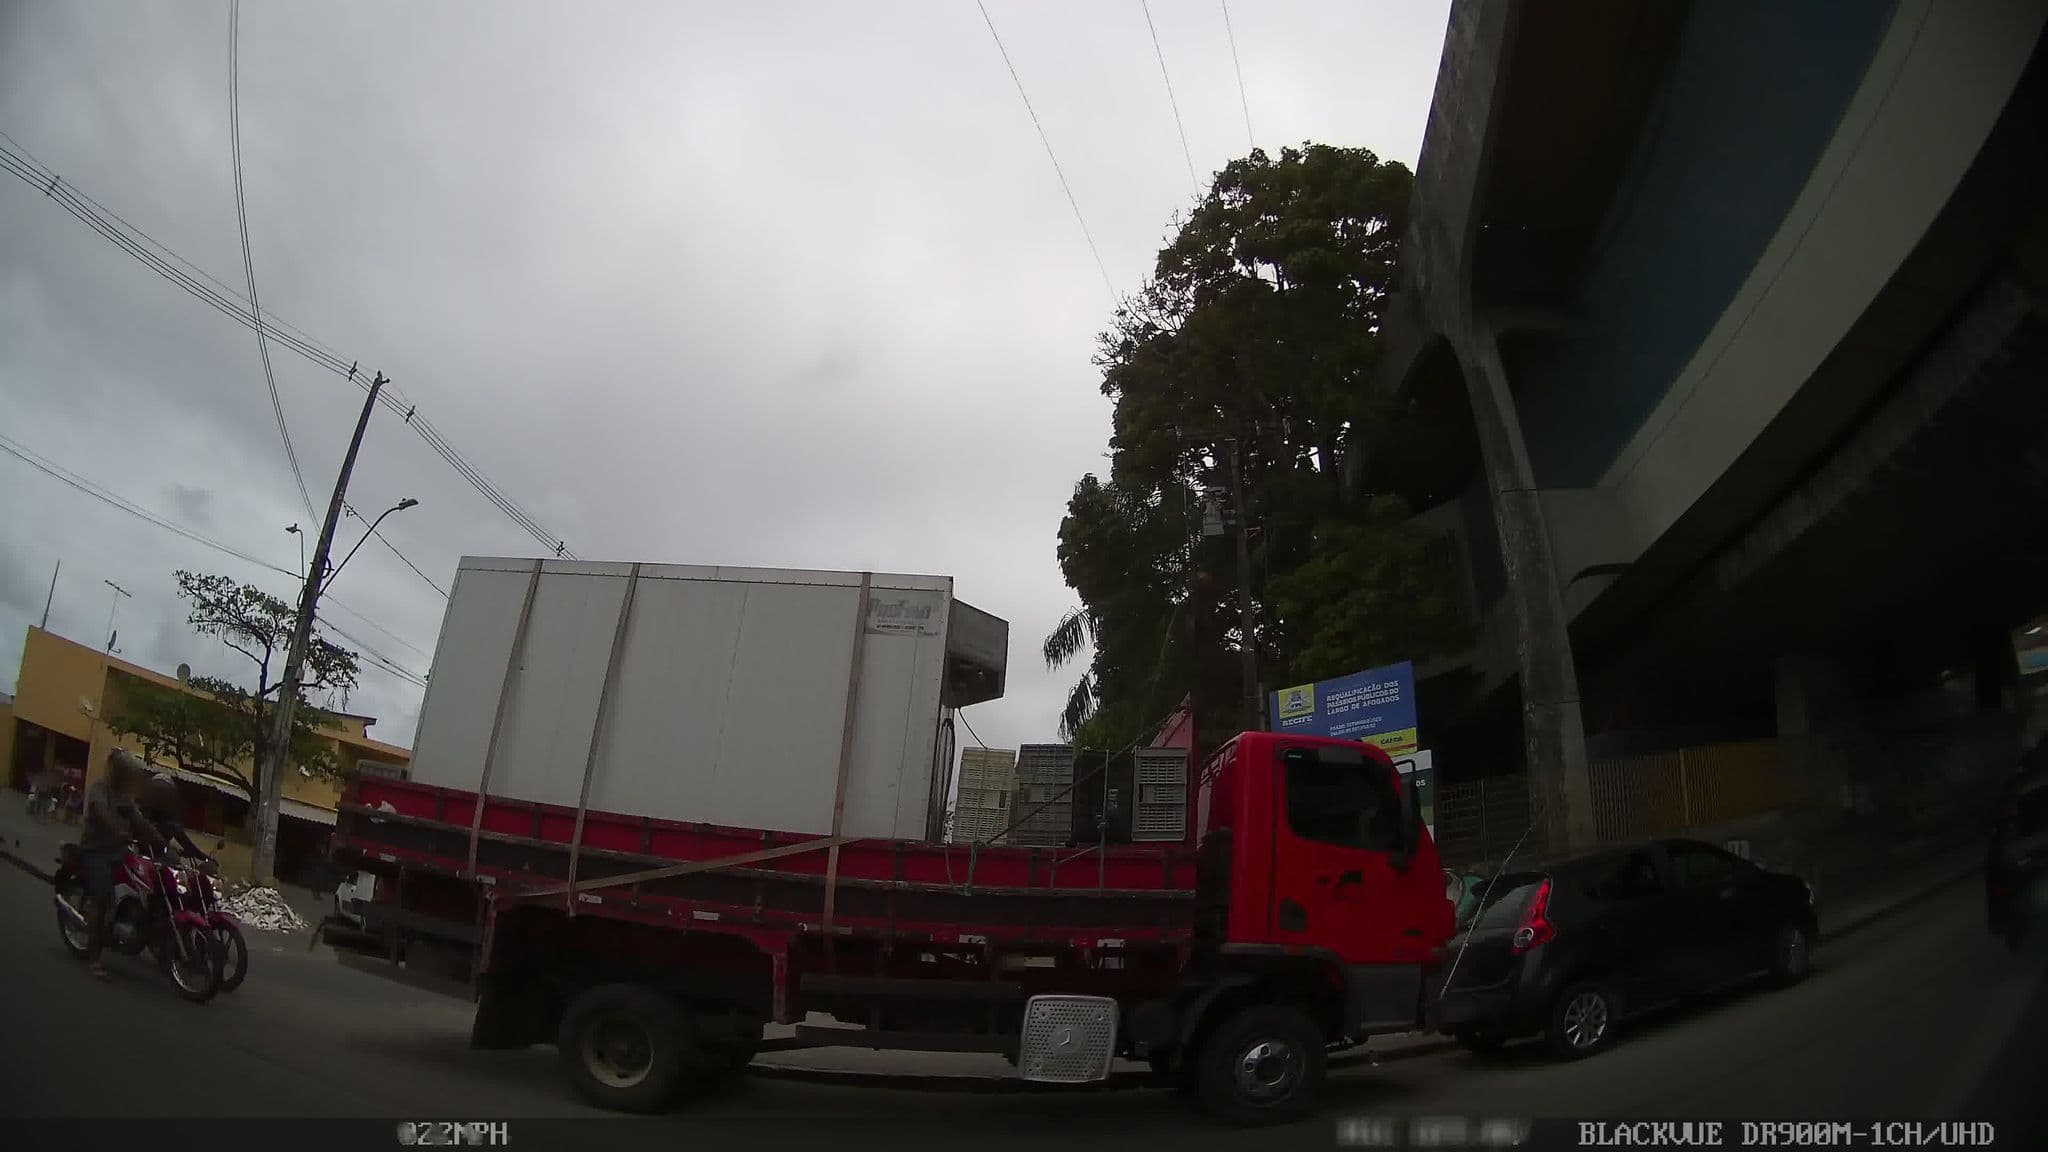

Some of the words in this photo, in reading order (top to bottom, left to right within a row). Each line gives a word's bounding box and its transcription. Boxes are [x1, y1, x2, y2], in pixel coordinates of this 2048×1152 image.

[1384, 680, 1399, 689] DOS
[1389, 687, 1399, 695] DO
[1327, 705, 1349, 715] LARGO
[1362, 694, 1400, 707] AFOGADOS
[1282, 715, 1313, 726] RECIFE
